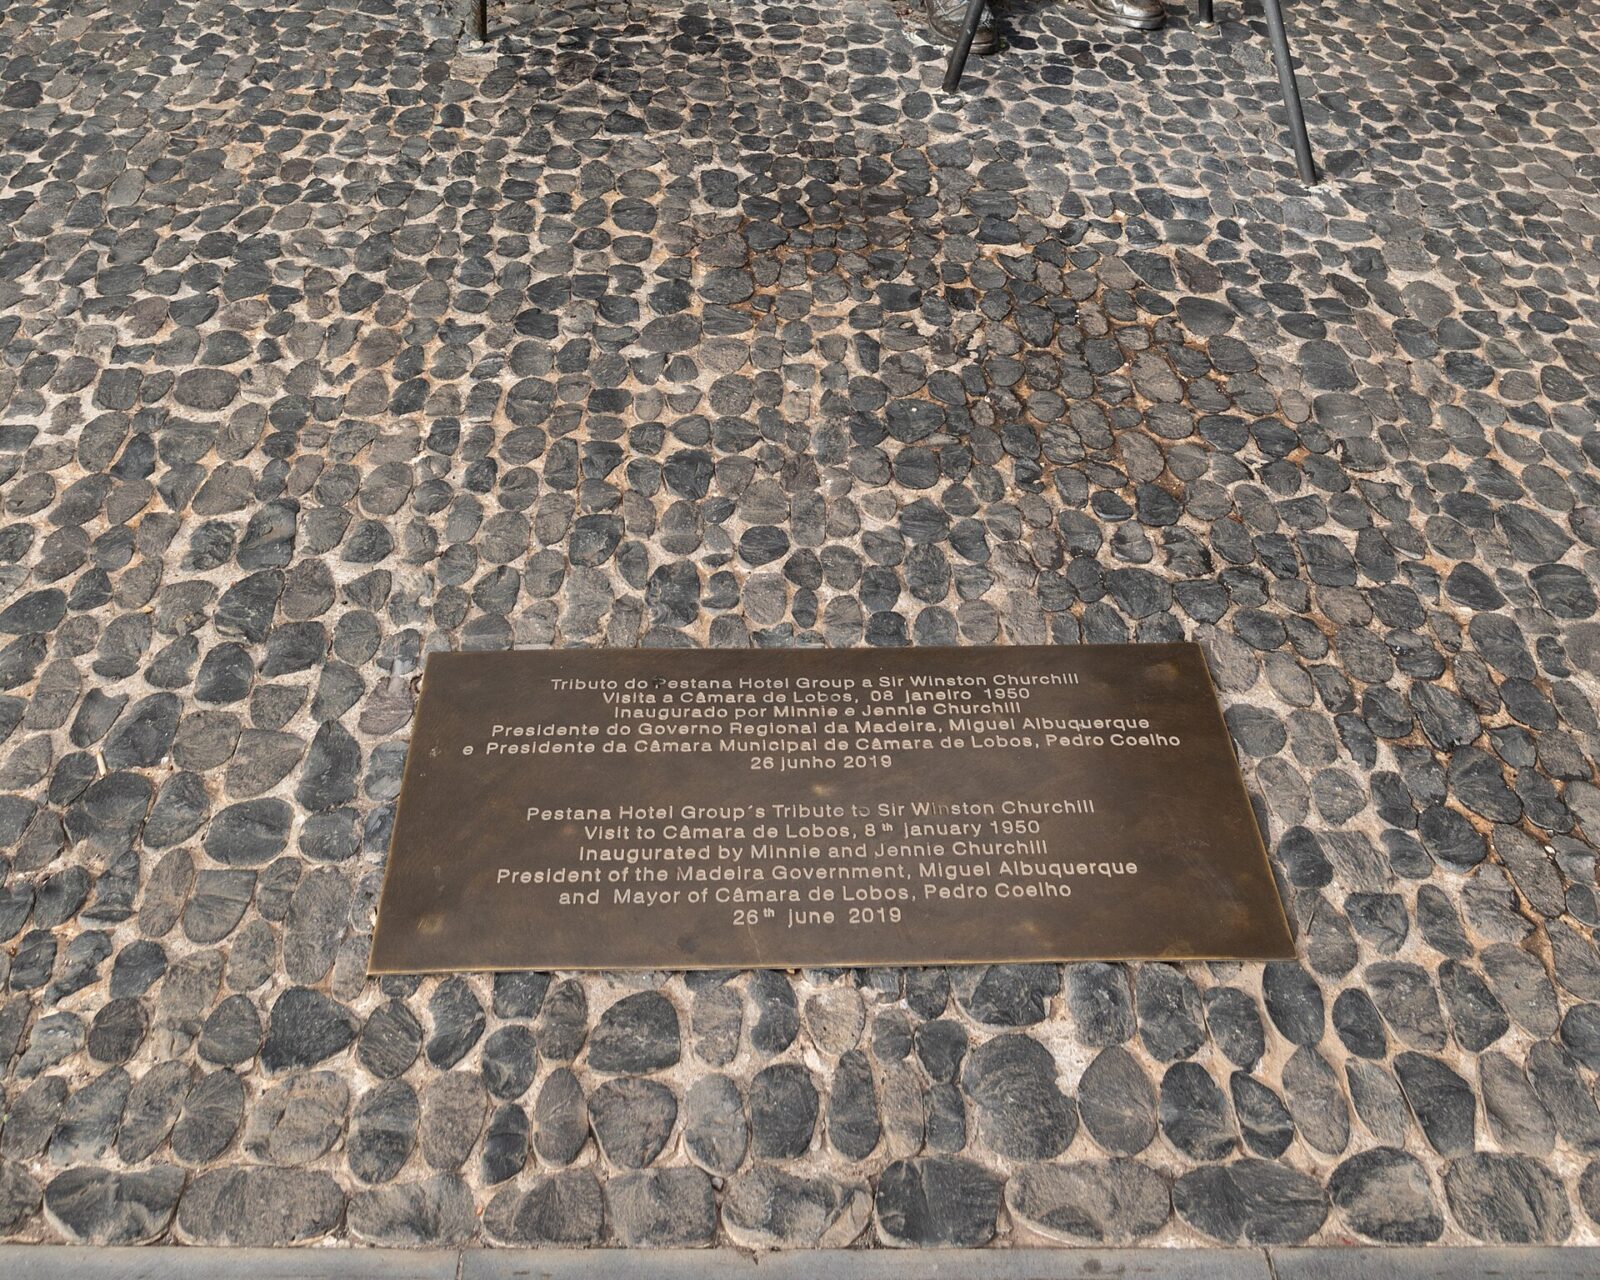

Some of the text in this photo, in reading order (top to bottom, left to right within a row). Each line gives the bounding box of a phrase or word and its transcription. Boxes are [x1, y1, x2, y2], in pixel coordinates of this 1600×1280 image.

[551, 673, 1078, 690] Tributo do Pestana Hotel Group a Sir Winston Churchill
[603, 688, 1029, 704] Visita a Câmara de Lobos, 08 janeiro 1950
[615, 702, 1020, 720] Inaugurado por Minnie e Jennie Churchill
[492, 718, 1149, 737] Presidente do Governo Regional da Madeira, Miguel Albuquerque
[463, 734, 1180, 755] e Presidente da Câmara Municipal de Câmara de Lobos, Pedro Coelho
[751, 755, 891, 771] 26 junho 2019
[527, 807, 611, 821] Pestana
[619, 806, 672, 819] Hotel
[772, 804, 844, 818] Tribute
[852, 804, 870, 817] to
[878, 803, 904, 816] Sir
[911, 802, 994, 815] Winston
[1002, 800, 1094, 814] Churchill
[585, 826, 629, 840] Visit
[636, 826, 655, 839] to
[663, 825, 745, 839] Câmara
[753, 825, 778, 838] de
[786, 824, 856, 839] Lobos,
[904, 822, 981, 839] january
[990, 820, 1039, 834] 1950
[580, 840, 1047, 863] Inaugurated by Minnie and Jennie Churchill
[497, 861, 1137, 883] President of the Madeira Government, Miguel Albuquerque
[559, 882, 1071, 906] and Mayor of Câmara de Lobos, Pedro Coelho
[788, 909, 834, 928] june
[849, 907, 901, 923] 2019
